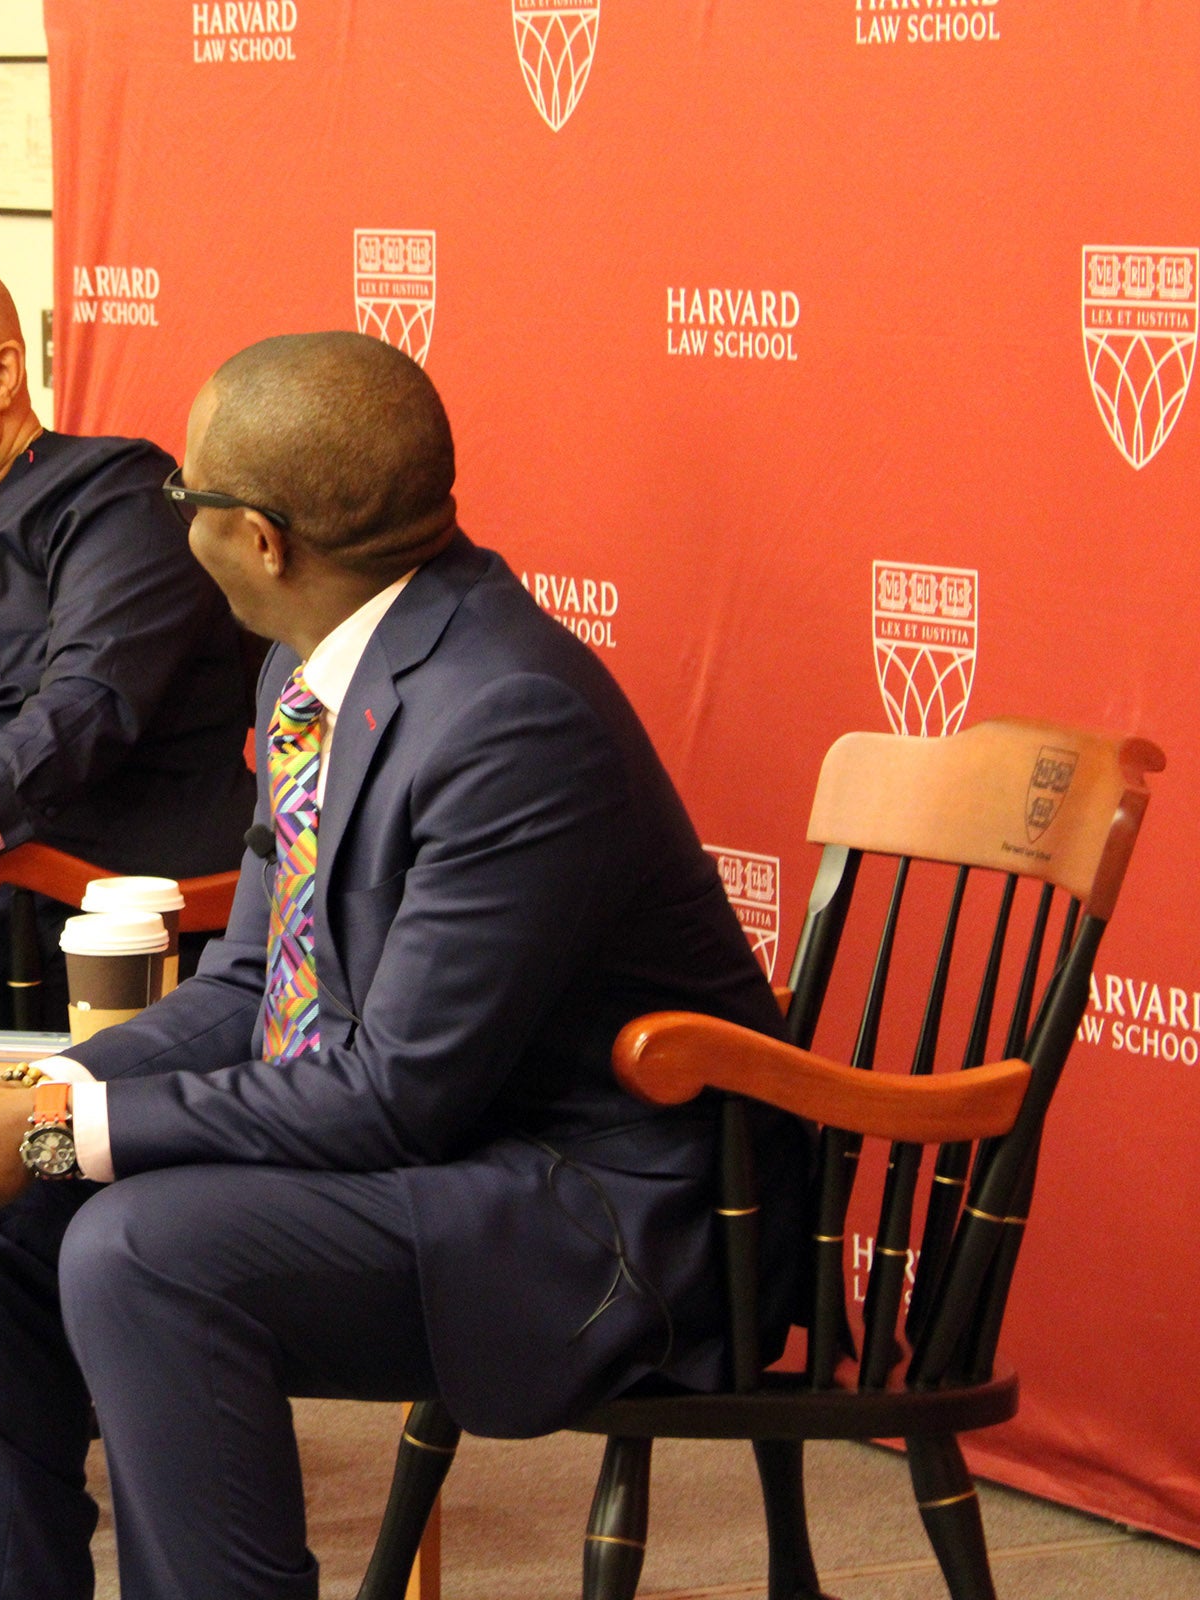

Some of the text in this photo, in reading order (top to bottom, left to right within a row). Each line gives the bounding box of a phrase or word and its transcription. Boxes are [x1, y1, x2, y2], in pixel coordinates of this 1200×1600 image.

[192, 0, 298, 35] HARVARD
[856, 11, 1001, 44] LAW SCHOOL
[193, 36, 297, 63] LAW SCHOOL
[361, 282, 377, 295] LEX
[379, 282, 390, 296] ET
[1164, 265, 1186, 286] TAS
[72, 301, 160, 327] AW SCHOOL
[666, 287, 801, 328] HARVARD
[1091, 308, 1190, 329] LEX ET IUSTITIA
[667, 328, 798, 361] LAW SCHOOL
[881, 620, 970, 646] LEX ET IUSTITIA
[1089, 971, 1200, 1033] ARVAR
[1111, 1020, 1199, 1067] SCHOO
